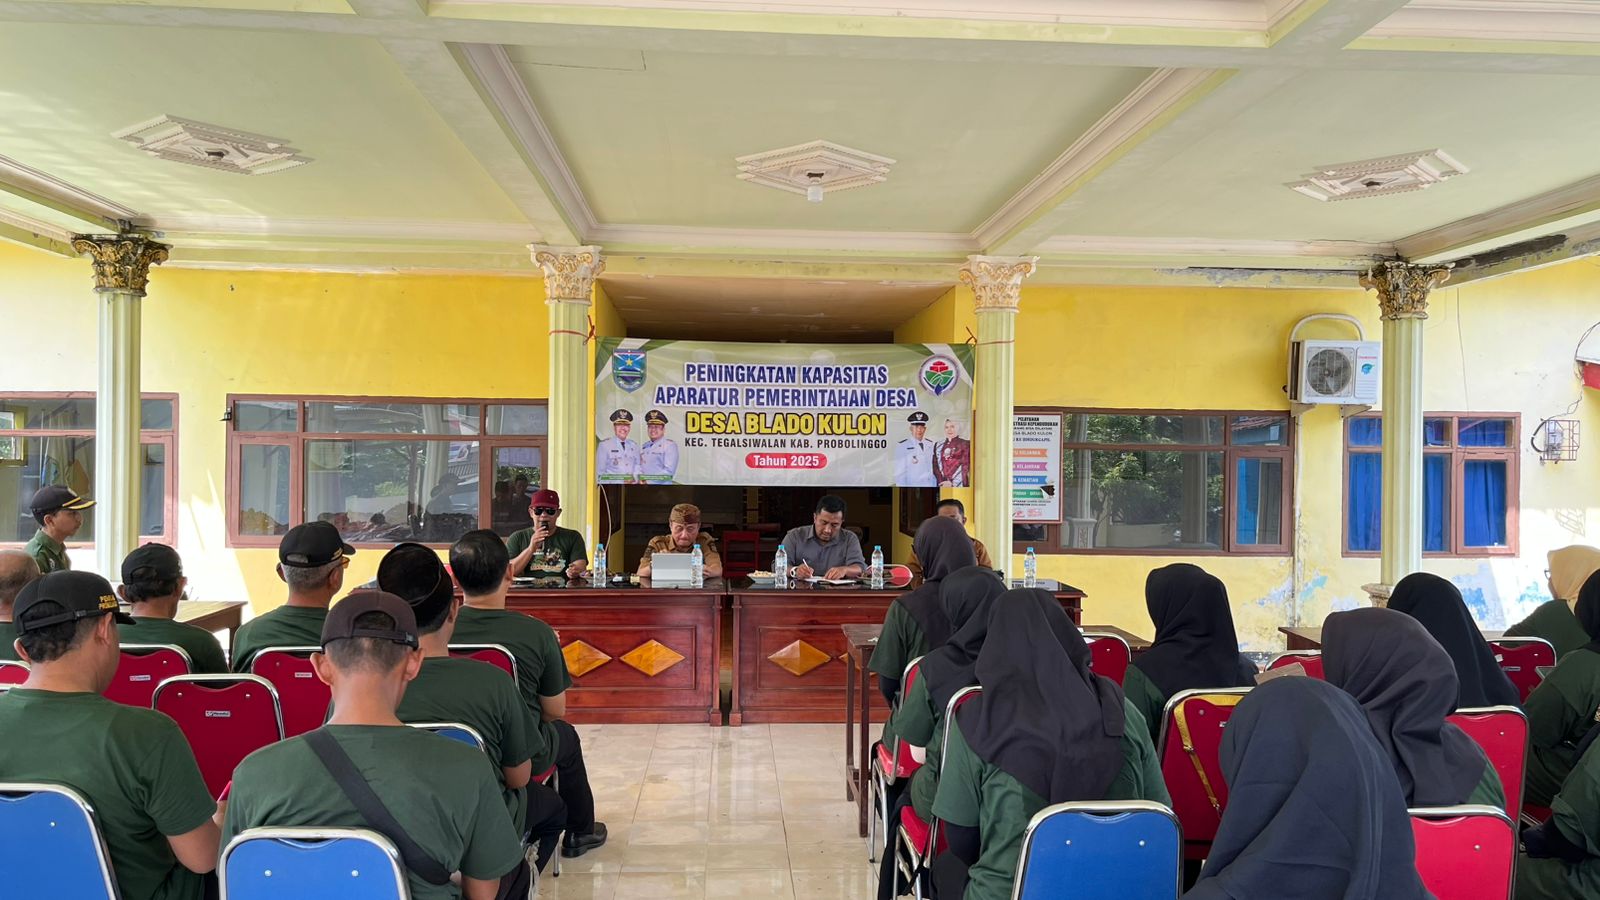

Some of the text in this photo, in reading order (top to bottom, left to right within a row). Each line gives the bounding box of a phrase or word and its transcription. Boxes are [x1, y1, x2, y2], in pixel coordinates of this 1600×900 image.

[685, 363, 888, 384] PENINGKATAN KAPASITAS
[655, 386, 917, 408] APARATUR PEMERINTAHAN DESA
[686, 411, 887, 436] DESA BLADO KULON
[685, 438, 887, 449] KEC. TEGALSIWALAN KAB. PROBOLINGGO
[753, 455, 820, 467] Tahun 2025
